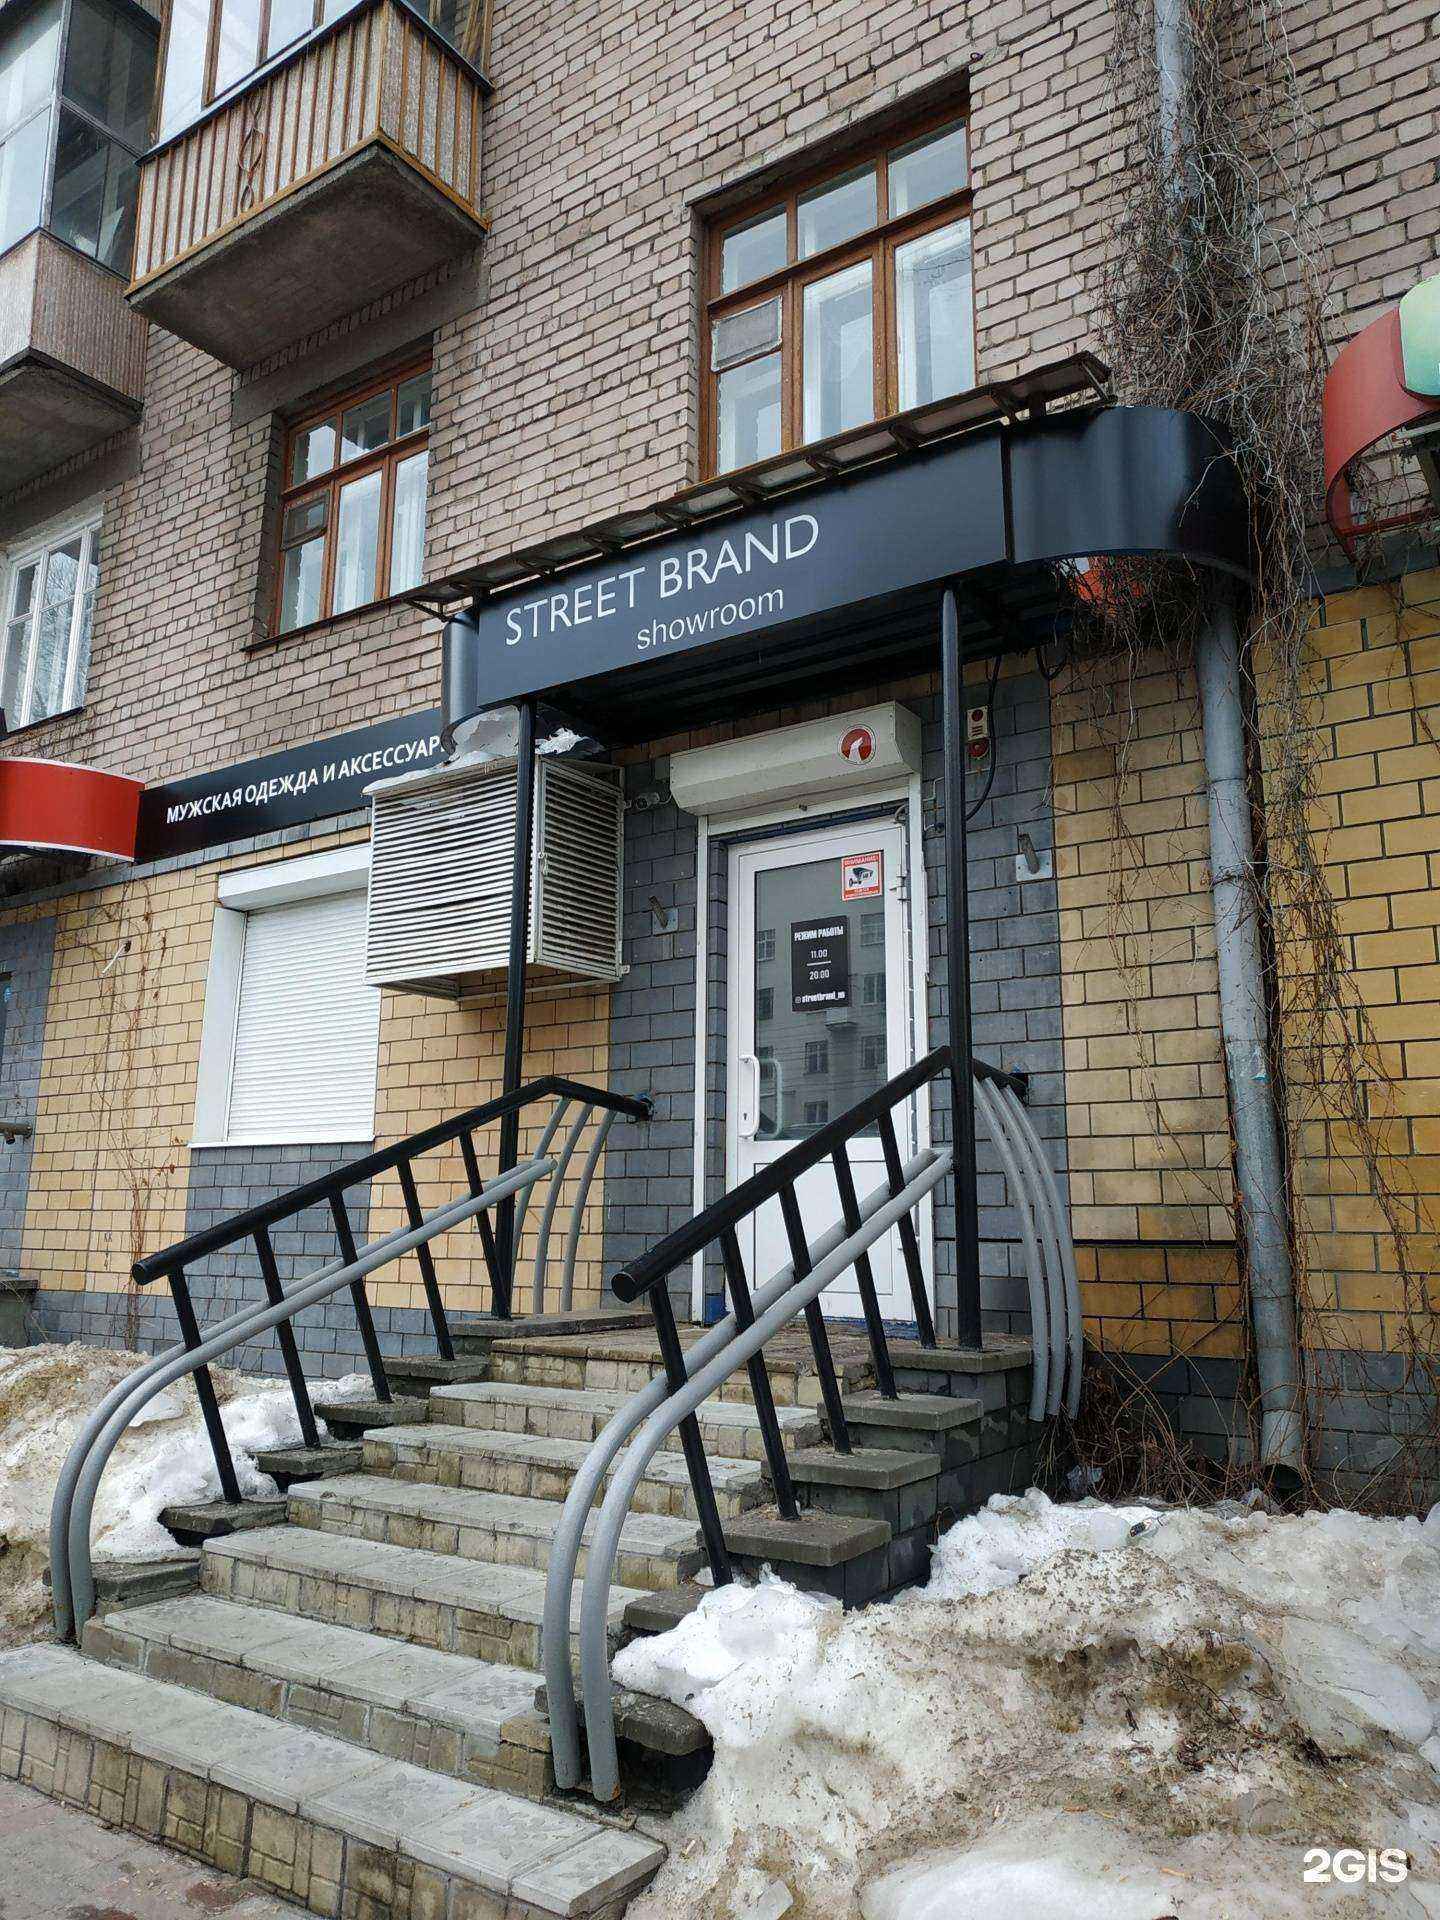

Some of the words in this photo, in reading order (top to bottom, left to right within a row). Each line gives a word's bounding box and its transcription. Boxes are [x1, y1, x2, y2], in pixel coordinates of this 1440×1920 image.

[505, 566, 646, 646] STREET
[659, 514, 819, 599] BRAND
[637, 588, 784, 650] showroom
[166, 788, 243, 824] МУЖСКАЯ
[244, 768, 319, 806] ОДЕЖДА
[322, 762, 336, 784] И
[337, 735, 445, 780] АКСЕССУАР
[794, 929, 818, 942] РЕЖИМ
[818, 926, 844, 938] РАБОТЫ
[810, 949, 828, 959] 11.00
[809, 969, 830, 980] 20.00
